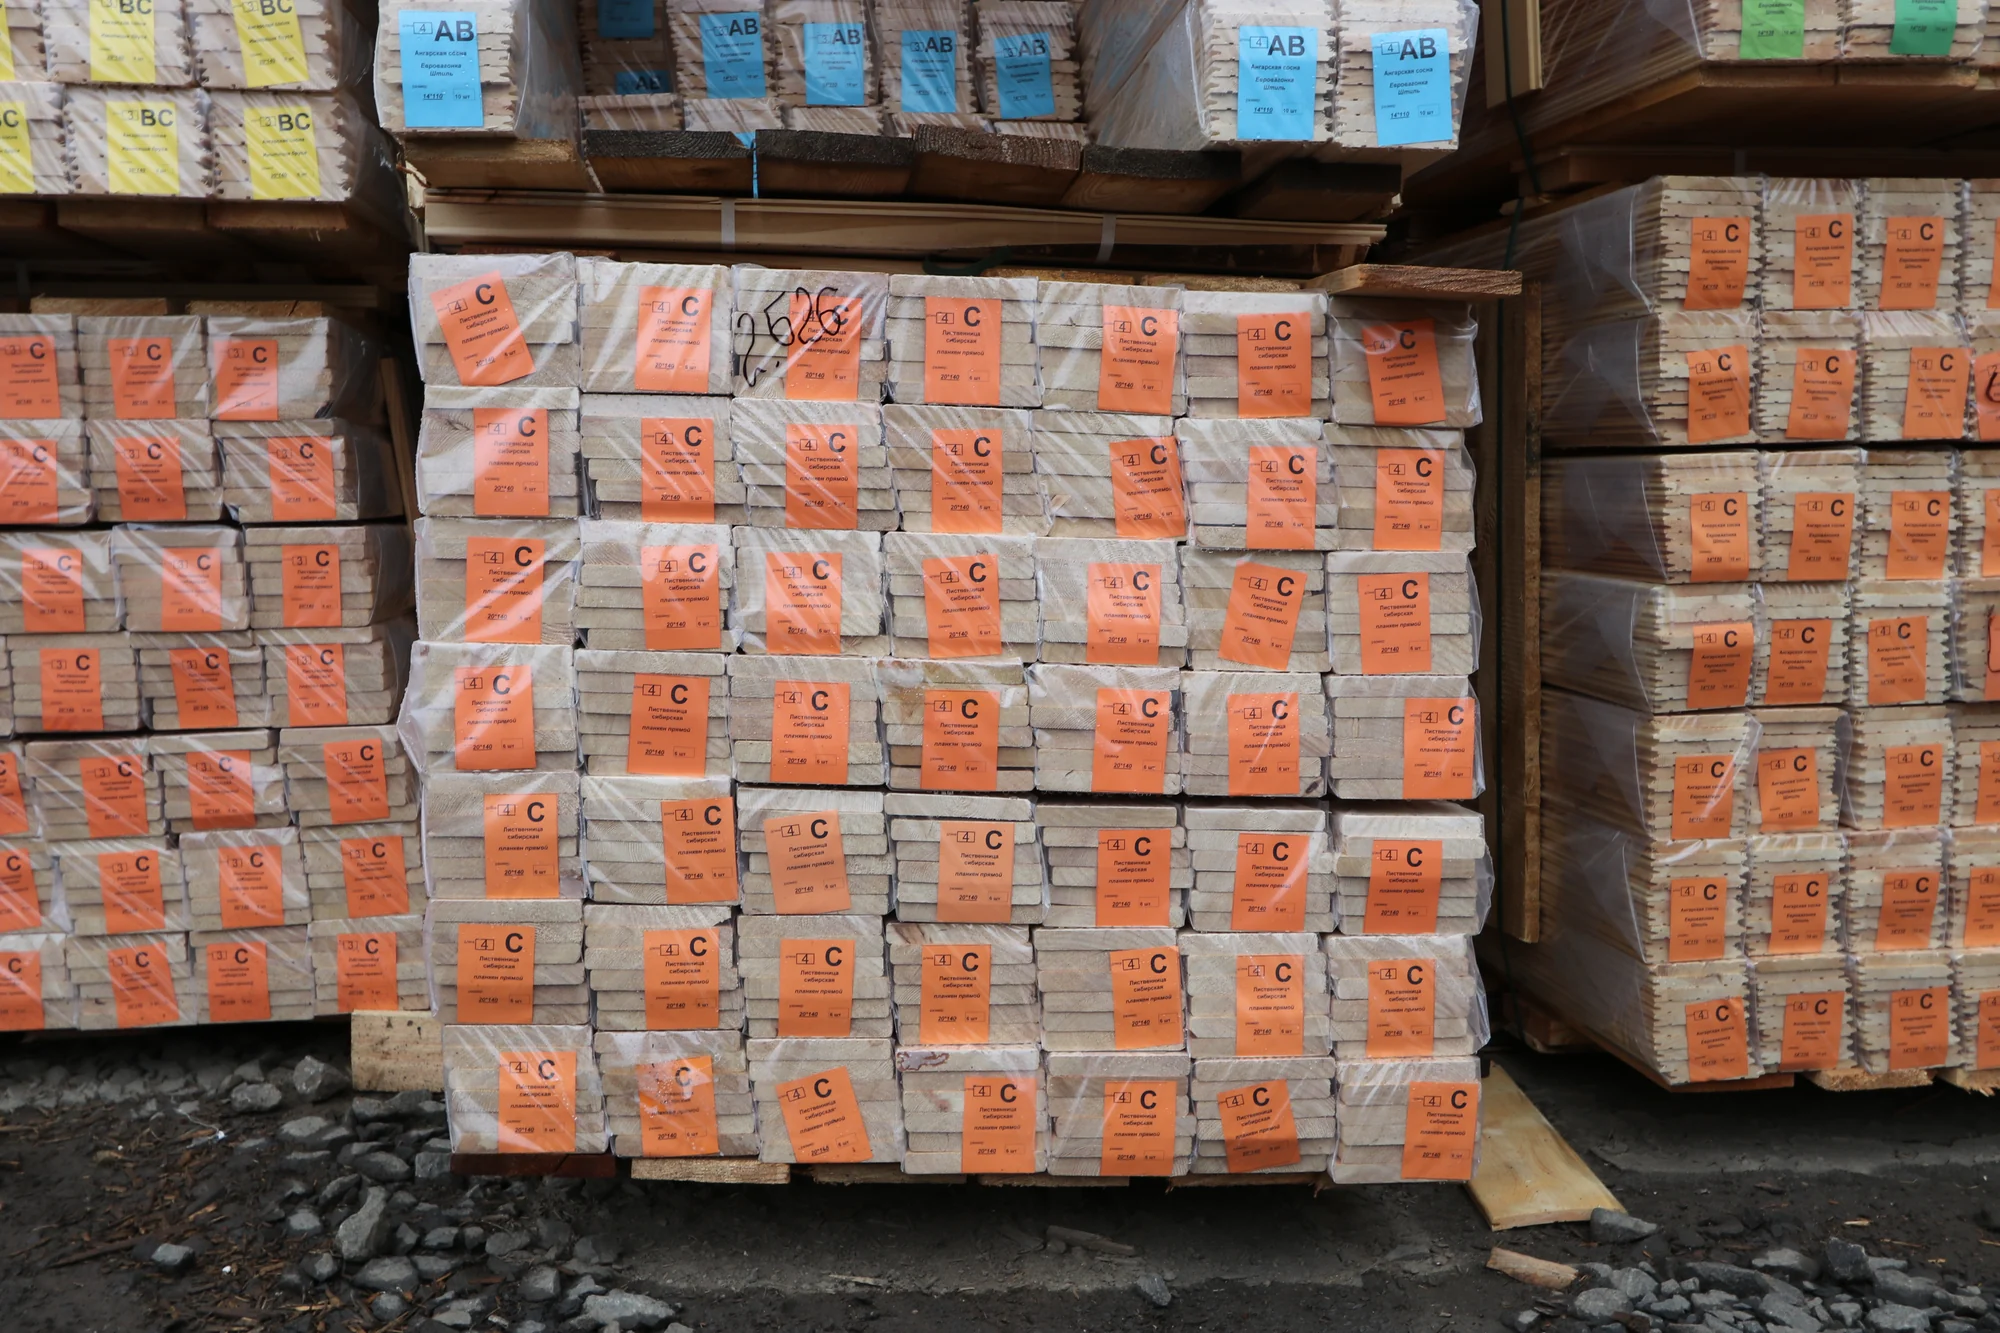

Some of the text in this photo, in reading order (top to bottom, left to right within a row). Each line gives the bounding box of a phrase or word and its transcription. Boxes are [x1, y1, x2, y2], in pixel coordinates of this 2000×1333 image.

[119, 0, 152, 14] BC
[260, 0, 293, 15] BC
[419, 20, 475, 42] 4 AB
[729, 18, 758, 36] AB
[832, 29, 860, 45] AB
[925, 37, 953, 52] AB
[1256, 35, 1305, 56] 4 AB
[1018, 40, 1046, 56] AB
[1387, 37, 1437, 61] 4 AB
[1390, 80, 1428, 89] Евровагонка
[140, 109, 173, 127] BC
[277, 112, 310, 131] BC
[1725, 224, 1738, 242] C
[1920, 224, 1933, 240] C
[475, 284, 495, 305] C
[682, 296, 698, 316] C
[964, 306, 980, 327] C
[1141, 316, 1157, 336] C
[1253, 321, 1291, 341] 4 C
[1400, 333, 1415, 349] C
[30, 343, 45, 359] C
[253, 347, 267, 363] C
[1826, 356, 1839, 373] C
[519, 417, 535, 437] C
[685, 426, 702, 447] C
[148, 443, 161, 460] C
[829, 433, 845, 452] C
[974, 437, 990, 457] C
[1150, 445, 1167, 465] C
[1288, 455, 1304, 474] C
[1416, 458, 1432, 477] C
[1724, 499, 1737, 516] C
[1927, 500, 1940, 516] C
[316, 551, 329, 566] C
[515, 546, 532, 567] C
[689, 554, 706, 573] C
[812, 561, 829, 580] C
[969, 563, 986, 583] C
[1133, 571, 1149, 591] C
[1277, 577, 1294, 596] C
[1380, 580, 1418, 599] 4 C
[1802, 627, 1815, 644] C
[76, 655, 89, 670] C
[206, 654, 218, 669] C
[493, 675, 510, 695] C
[648, 684, 688, 704] 4 C
[648, 706, 687, 714] Лиственница
[812, 691, 828, 711] C
[962, 699, 978, 719] C
[1142, 698, 1158, 718] C
[1272, 700, 1288, 720] C
[1448, 706, 1463, 725] C
[360, 746, 373, 761] C
[1920, 750, 1933, 766] C
[527, 802, 544, 822] C
[704, 806, 721, 826] C
[811, 819, 828, 839] C
[986, 830, 1002, 850] C
[1113, 837, 1151, 856] 4 C
[250, 853, 263, 867] C
[1273, 842, 1288, 861] C
[1407, 848, 1422, 867] C
[1704, 884, 1717, 900] C
[505, 933, 523, 953] C
[690, 937, 707, 957] C
[802, 947, 842, 966] 4 C
[962, 952, 978, 972] C
[1150, 954, 1167, 973] C
[1275, 963, 1291, 982] C
[1407, 966, 1423, 985] C
[538, 1059, 555, 1080] C
[814, 1078, 832, 1098] C
[1000, 1084, 1016, 1103] C
[1253, 1087, 1269, 1106] C
[1140, 1090, 1156, 1110] C
[1451, 1090, 1467, 1109] C
